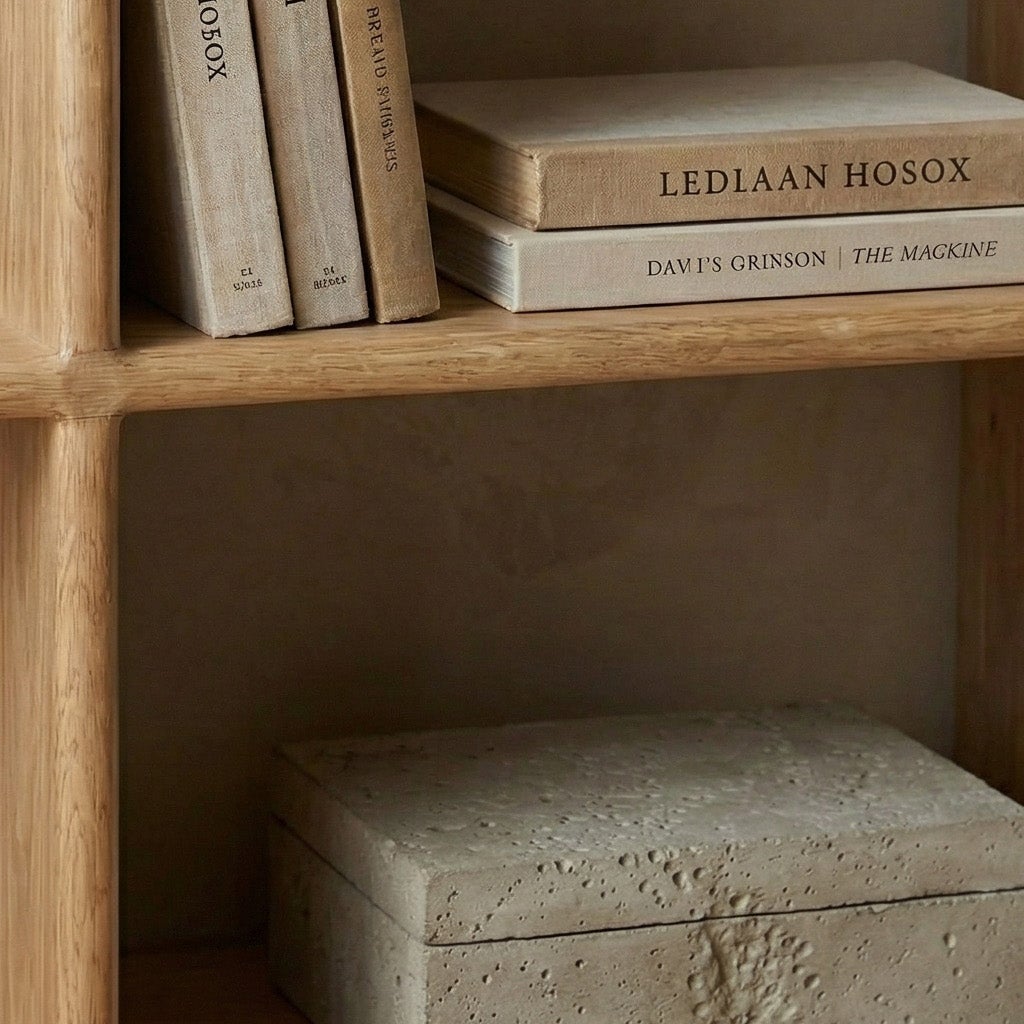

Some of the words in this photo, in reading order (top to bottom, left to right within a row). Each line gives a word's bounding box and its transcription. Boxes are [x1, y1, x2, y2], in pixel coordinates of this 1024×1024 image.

[658, 163, 829, 197] LEDLAAN
[843, 156, 972, 188] HOSOX
[730, 250, 826, 272] GRINSON
[852, 246, 894, 265] THE
